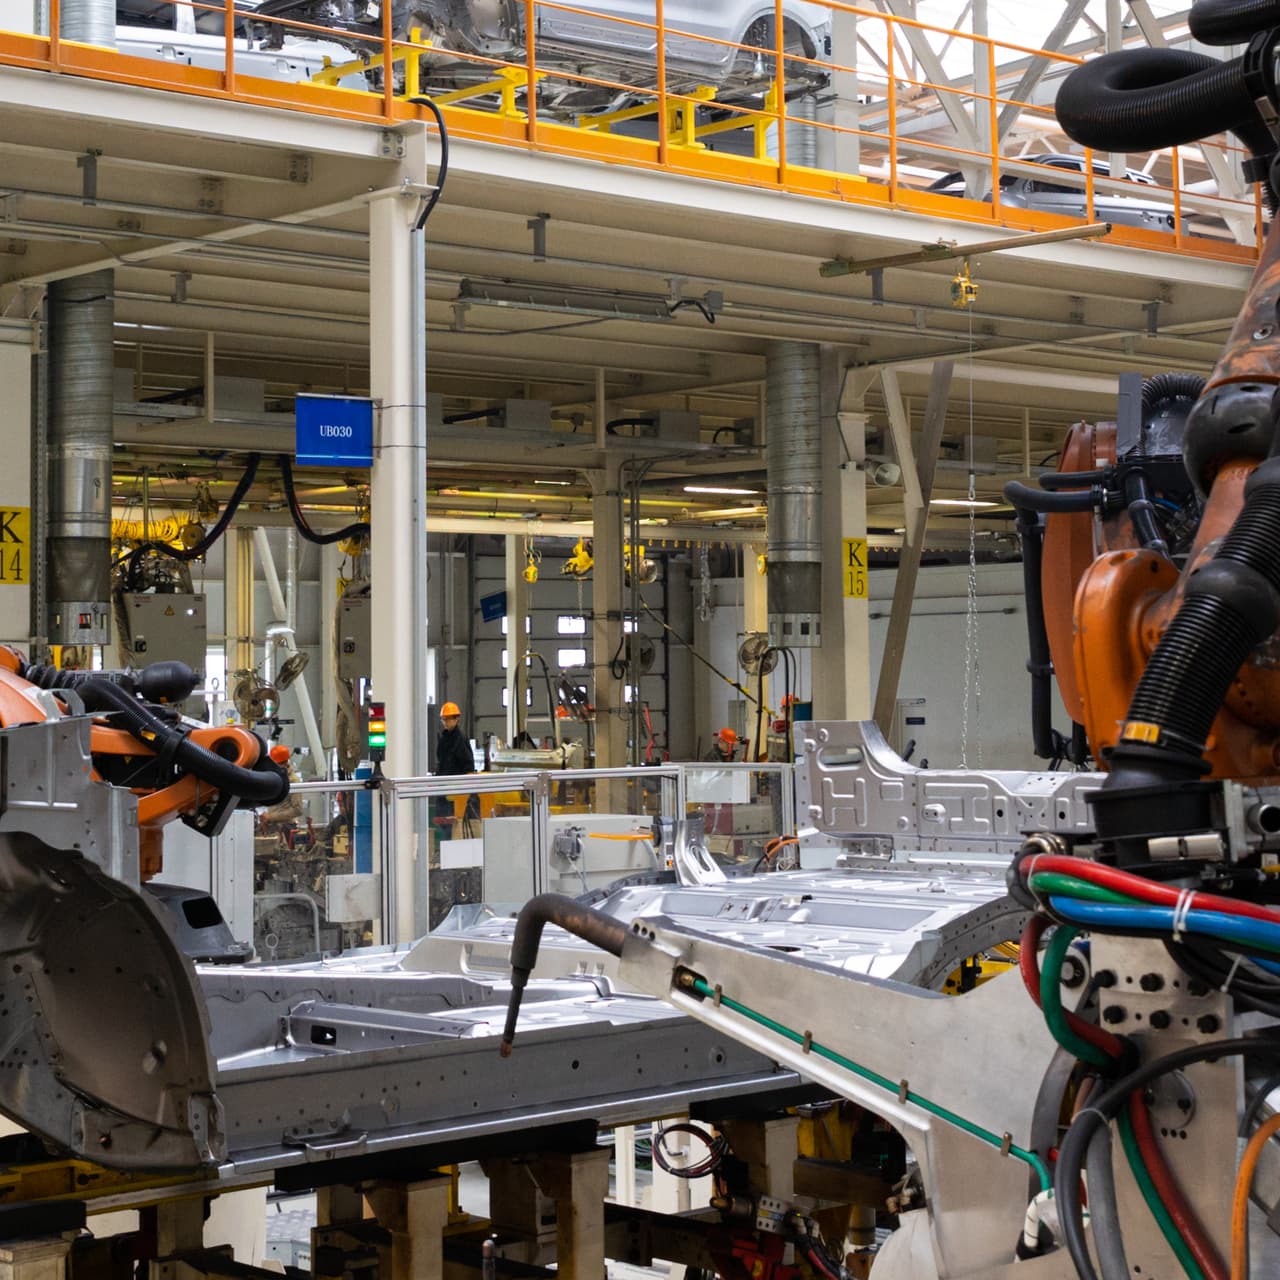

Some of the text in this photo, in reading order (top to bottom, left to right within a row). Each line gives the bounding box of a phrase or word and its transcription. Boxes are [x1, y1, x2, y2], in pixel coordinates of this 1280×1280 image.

[320, 425, 352, 438] UB030
[847, 542, 864, 567] K
[848, 571, 864, 596] 15
